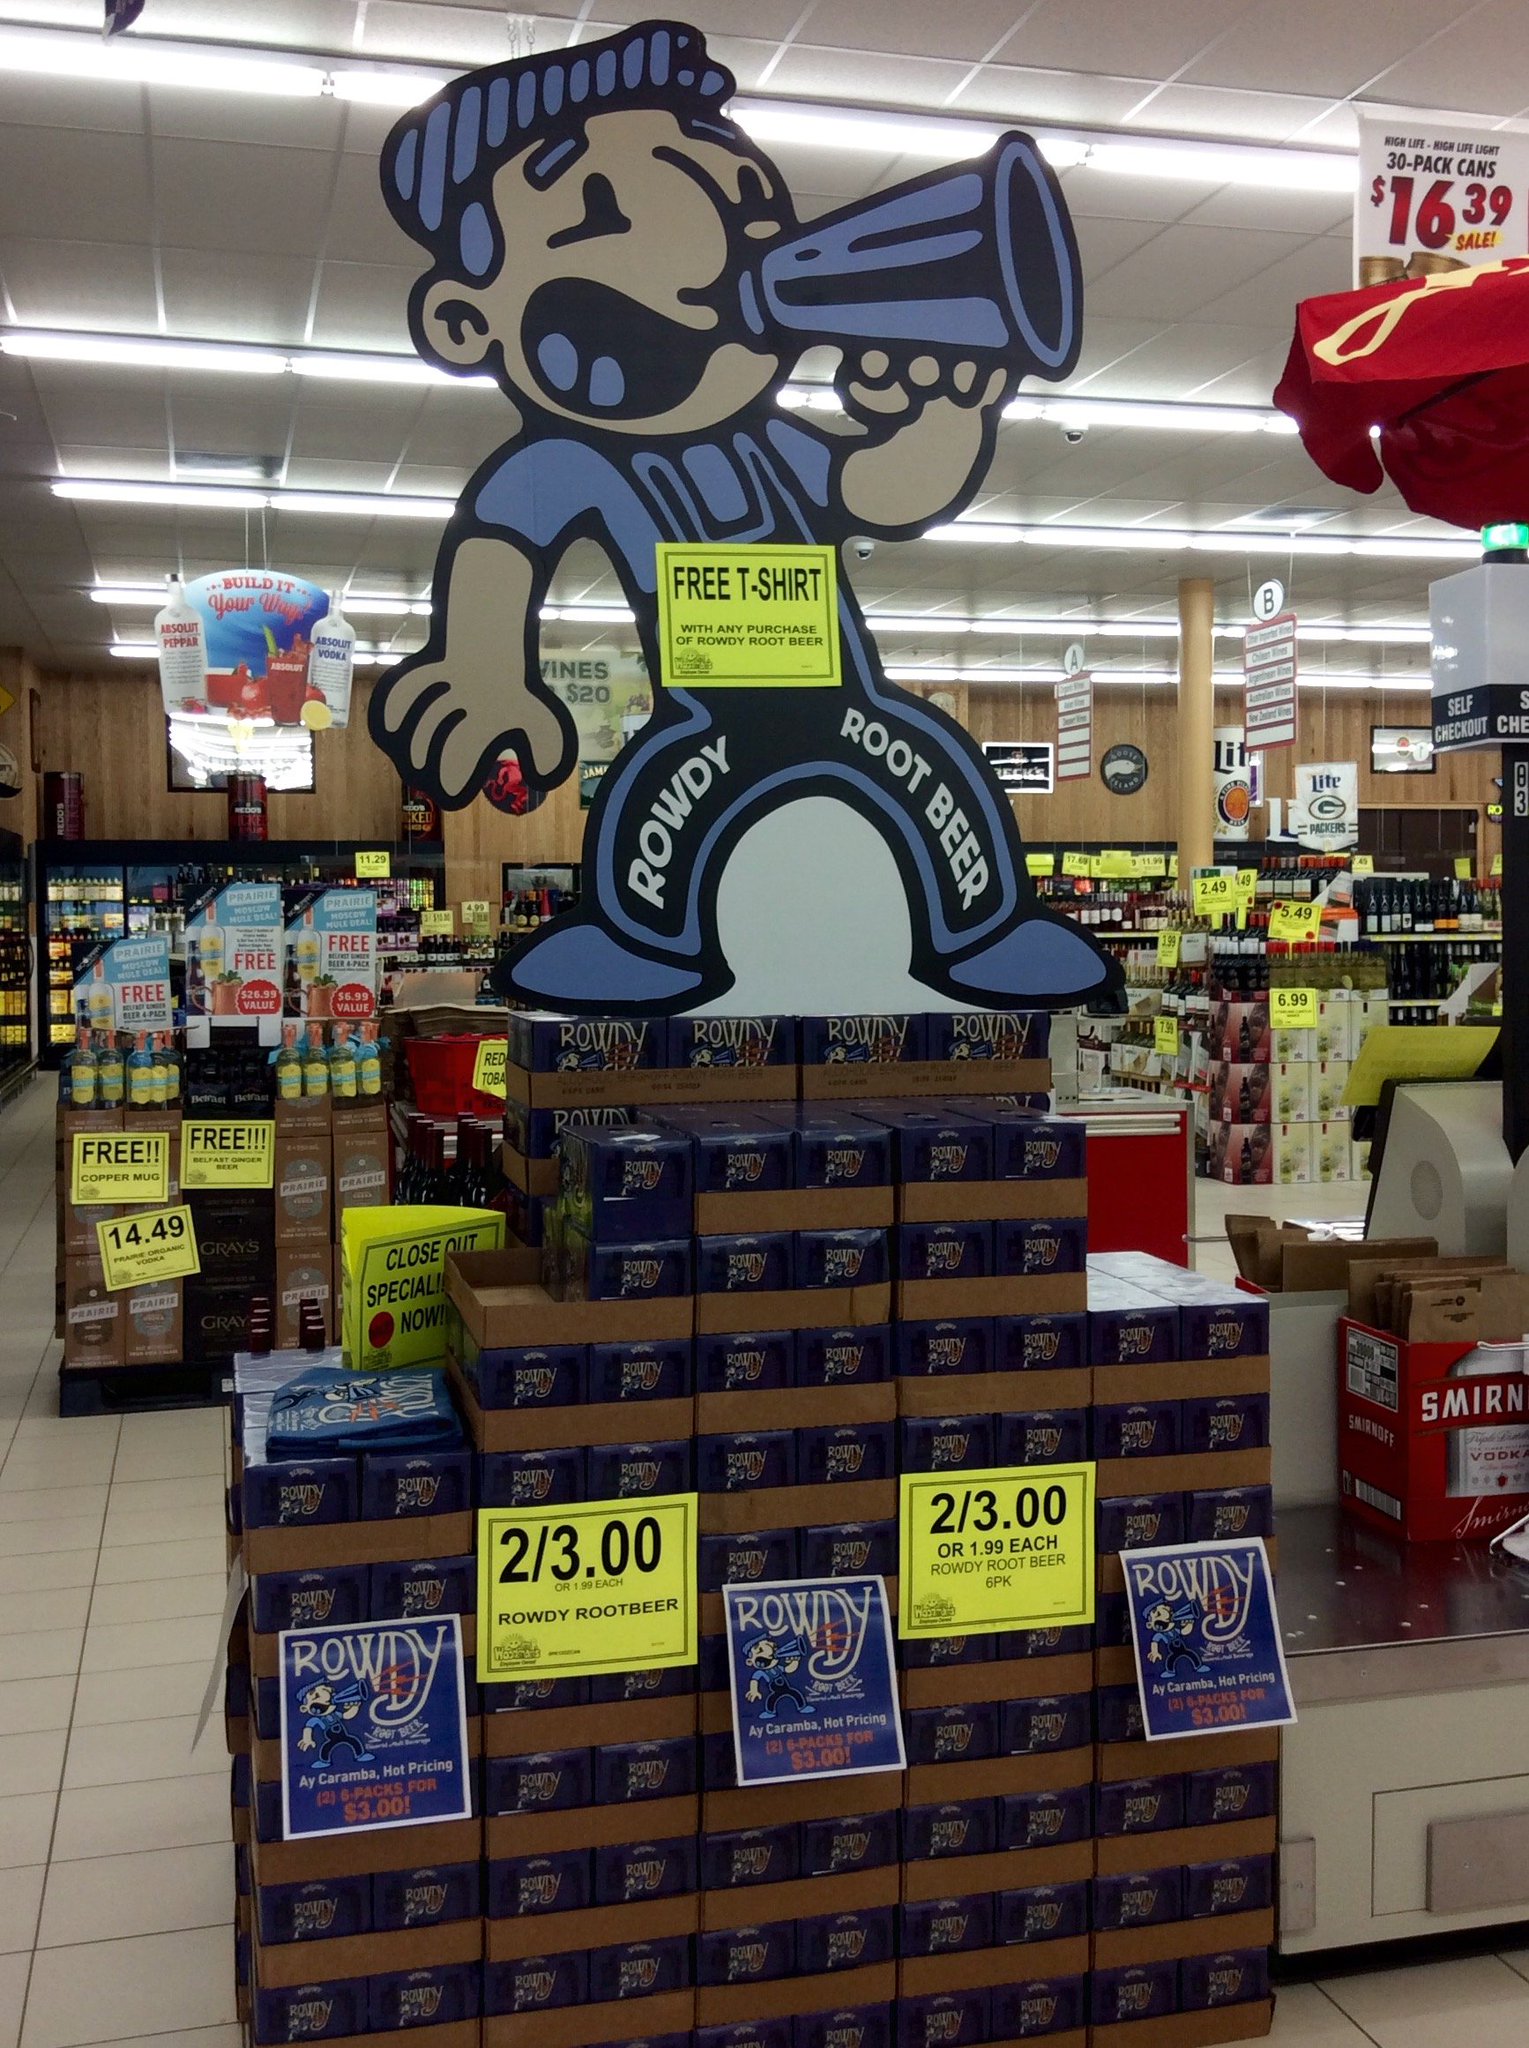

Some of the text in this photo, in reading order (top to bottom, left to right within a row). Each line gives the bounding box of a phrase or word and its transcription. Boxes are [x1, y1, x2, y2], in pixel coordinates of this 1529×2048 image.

[1385, 136, 1500, 156] HIGH LIFE HIGH LIFE LIGHT
[1386, 152, 1497, 179] 30-PACK CANS
[1455, 231, 1497, 251] SALE!
[222, 576, 295, 594] BUILD IT
[673, 566, 822, 601] FREE T-SHIRT
[208, 594, 255, 620] Your
[1262, 588, 1275, 615] B
[160, 622, 199, 634] ABSOLUT
[681, 624, 818, 635] WITH ANY PURCHASE
[163, 636, 199, 648] PEPPAR
[315, 636, 352, 649] ABSOLUT
[676, 636, 824, 646] OF ROWDY ROOT BEER
[318, 649, 347, 661] VODKA
[1069, 650, 1079, 671] A
[270, 662, 304, 672] ABSOLUT
[567, 683, 611, 703] $20
[1447, 694, 1474, 717] SELF
[1434, 715, 1489, 743] CHECKOUT
[1213, 740, 1246, 774] Lit
[1311, 773, 1342, 792] Lite
[840, 706, 990, 911] ROOT BEER
[627, 735, 732, 910] ROWDY
[1309, 822, 1347, 835] PACKERS
[359, 855, 387, 864] 11.29
[229, 890, 276, 902] PRAIRIE
[1200, 880, 1228, 895] 2.49
[234, 904, 271, 914] MOSCOW
[326, 895, 373, 908] PRAIRIE
[330, 911, 367, 920] MOSCOW
[1279, 905, 1313, 921] 5.49
[326, 920, 349, 929] MULE
[116, 943, 164, 958] PRAIRIE
[328, 934, 370, 953] FREE
[1161, 934, 1176, 948] 3.99
[234, 952, 277, 971] FREE
[328, 960, 370, 968] BEER 4-PACK
[121, 984, 166, 1004] FREE
[241, 990, 277, 999] $26.99
[337, 992, 369, 1001] $6.99
[1277, 993, 1308, 1007] 6.99
[243, 1000, 275, 1010] VALUE
[337, 1003, 370, 1012] VALUE
[122, 1010, 167, 1020] BEER 4-PACK
[951, 1014, 1033, 1059] ROWDY
[1160, 1021, 1175, 1034] 7.99
[559, 1021, 648, 1069] ROWDY
[692, 1019, 778, 1066] ROWDY
[827, 1016, 912, 1063] ROWDY
[190, 1128, 266, 1150] FREE!!!
[82, 1141, 160, 1164] FREE!!
[81, 1173, 160, 1182] COPPER MUG
[283, 1178, 324, 1194] PRAIRIE
[342, 1172, 384, 1188] PRAIRIE
[108, 1215, 185, 1250] 14.49
[114, 1244, 185, 1263] PRAIRIE ORGANIC
[135, 1256, 165, 1266] VODKA
[386, 1233, 478, 1271] CLOSE OUT
[71, 1305, 116, 1319] PRAIRIE
[132, 1296, 177, 1310] PRAIRIE
[201, 1315, 250, 1331] GRAY
[1421, 1383, 1529, 1422] SMIRN
[1349, 1414, 1395, 1449] SMIRNOFF
[1470, 1449, 1529, 1462] VODKA
[930, 1485, 1068, 1534] 2/3.00
[498, 1516, 662, 1584] 2/3.00
[937, 1535, 1058, 1558] OR 1.99 EACH
[931, 1553, 1066, 1576] ROWDY ROOT BEER
[554, 1578, 624, 1592] OR 1.99 EACH
[985, 1576, 1012, 1589] 6PK
[1131, 1552, 1256, 1642] ROWDY
[498, 1598, 679, 1625] ROWDY ROOTBEER
[734, 1586, 873, 1680] ROWDY
[291, 1625, 448, 1726] ROWDY
[1152, 1670, 1276, 1696] Ay Caramba, Hot Pricing
[1240, 1688, 1266, 1701] FOR
[748, 1712, 887, 1738] Ay Caramba, Hot Pricing
[1191, 1705, 1246, 1726] $3.00!
[848, 1729, 874, 1744] FOR
[790, 1746, 851, 1771] $3.00!
[299, 1759, 454, 1789] Ay Caramba, Hot Pricing
[408, 1778, 438, 1793] FOR
[343, 1796, 412, 1822] $3.00!
